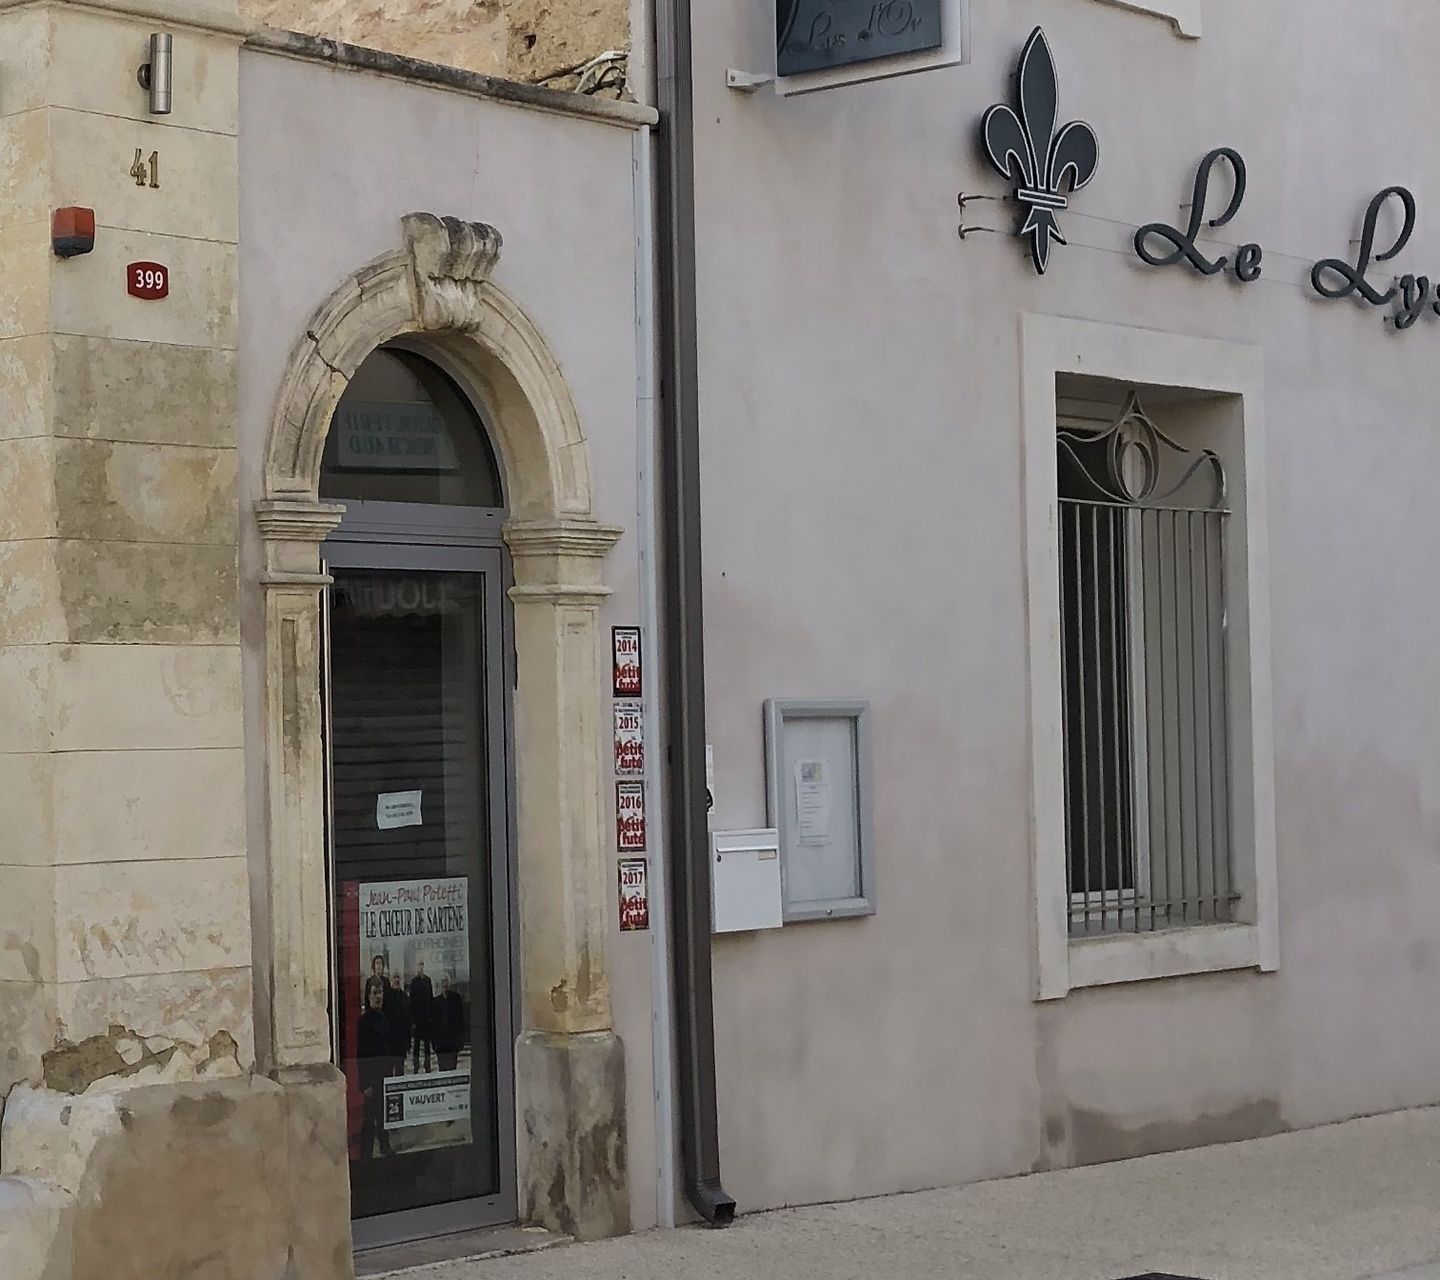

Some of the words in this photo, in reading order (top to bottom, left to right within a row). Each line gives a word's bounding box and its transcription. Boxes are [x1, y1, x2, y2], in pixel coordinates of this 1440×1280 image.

[130, 148, 160, 189] 41
[1133, 147, 1262, 282] Le
[135, 269, 164, 290] 399
[617, 639, 637, 652] 2014
[618, 716, 639, 729] 2015
[620, 795, 641, 809] 2016
[622, 871, 643, 885] 2017
[365, 886, 420, 908] Jean-Paul
[365, 910, 377, 938] LE
[414, 907, 425, 934] DE
[409, 1093, 445, 1105] VAUVERT
[389, 1103, 399, 1114] 26
